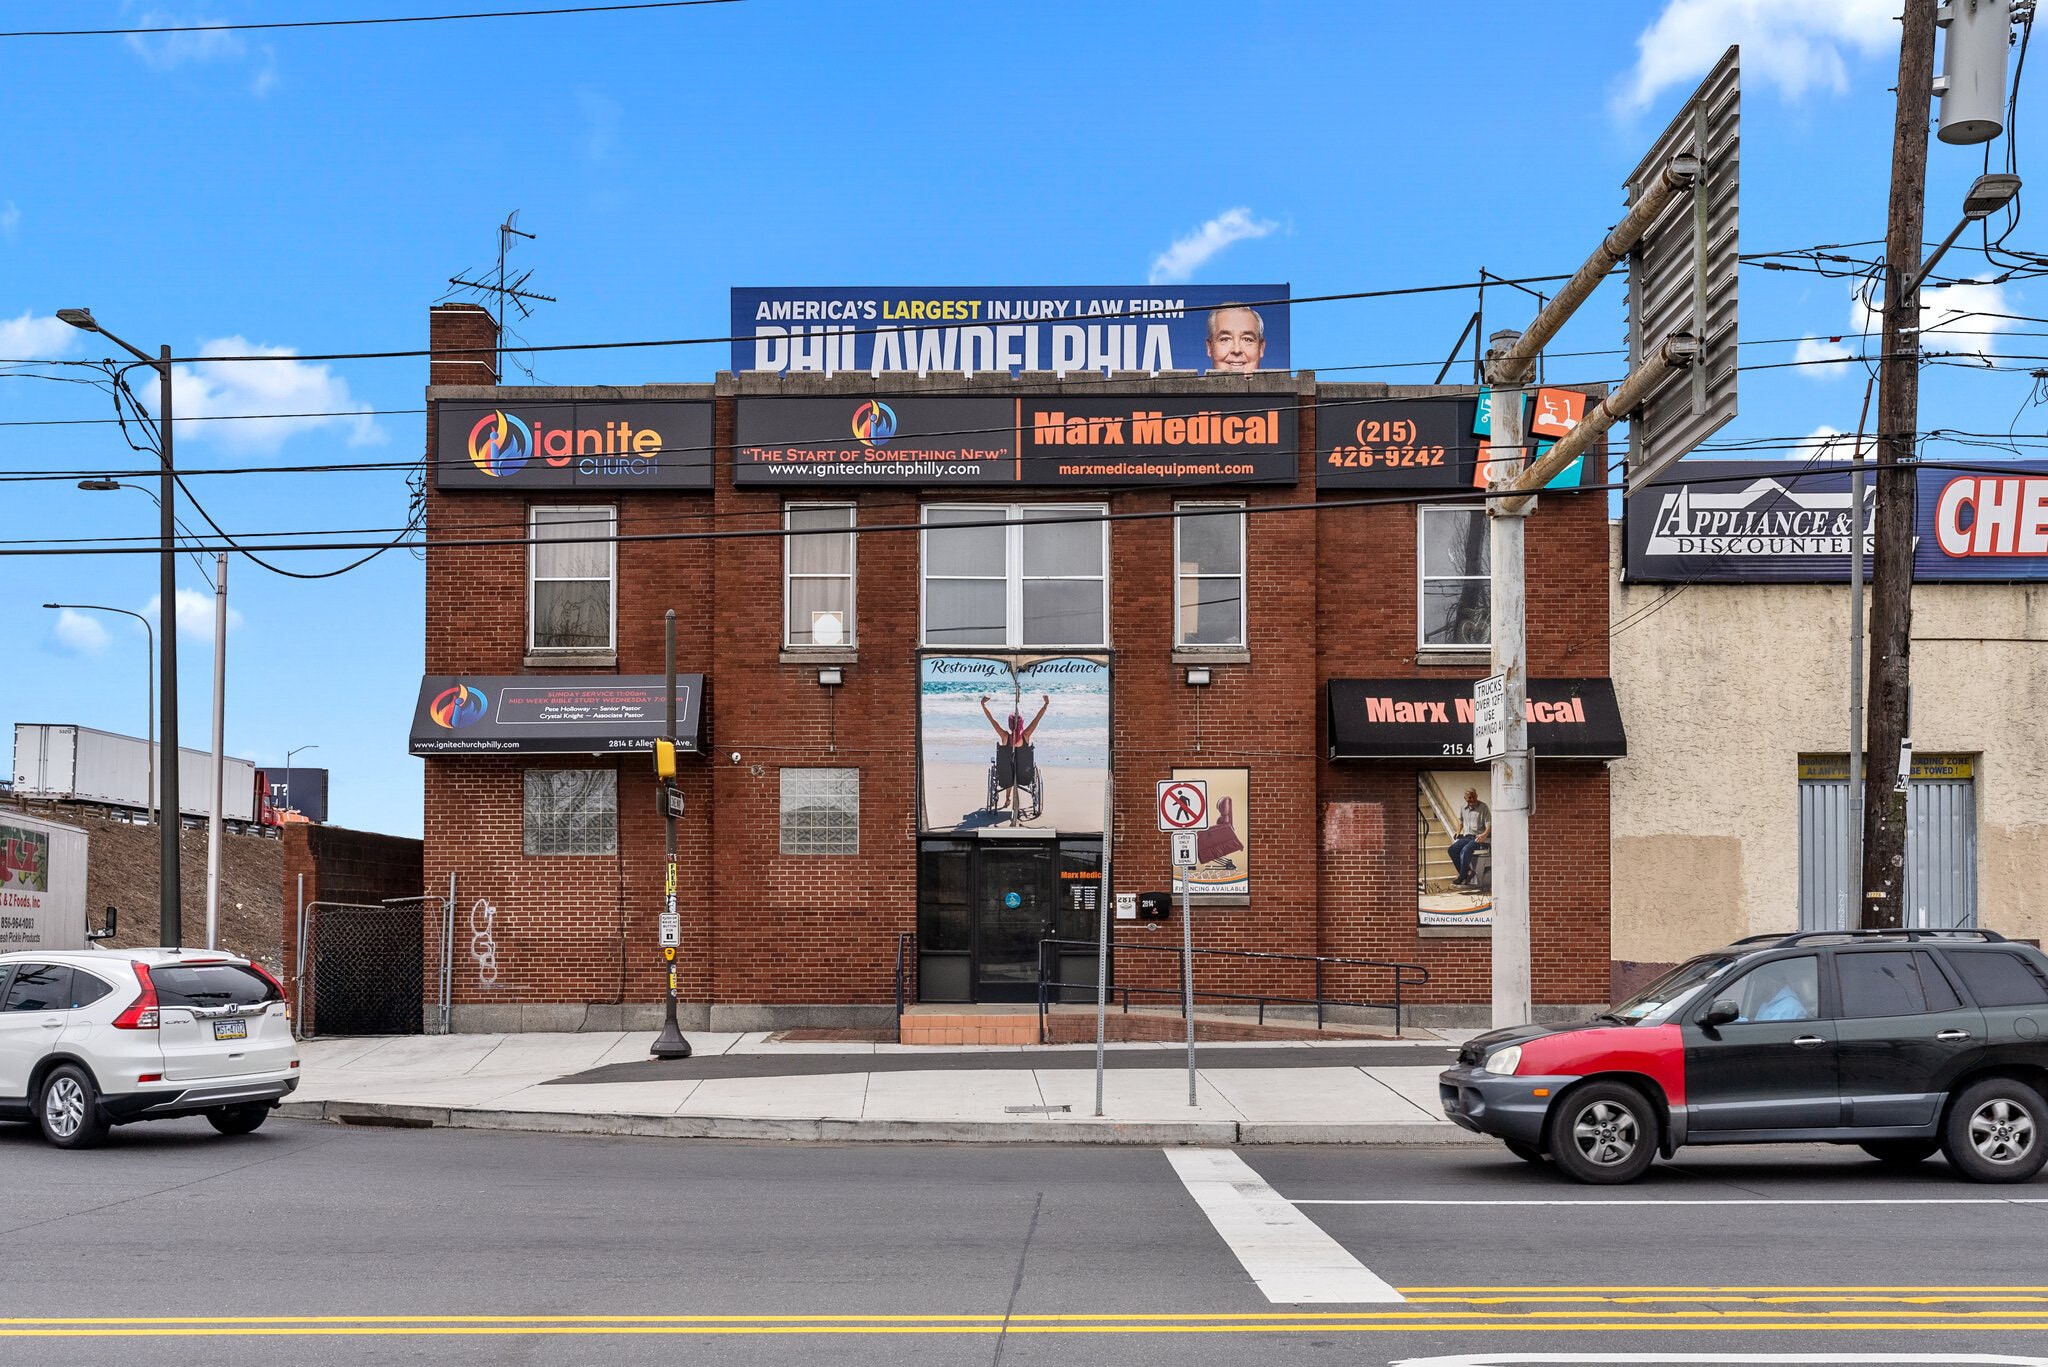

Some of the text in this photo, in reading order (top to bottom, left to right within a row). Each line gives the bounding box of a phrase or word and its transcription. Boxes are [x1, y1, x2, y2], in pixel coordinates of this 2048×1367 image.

[755, 299, 1185, 320] AMERICA'S LARGEST INJURY LAW FIRM
[1033, 411, 1279, 445] Marx Medical
[1356, 419, 1417, 446] (215)
[534, 421, 663, 467] ignite
[864, 449, 956, 461] SOMETHING
[1328, 446, 1445, 468] 426-9242
[579, 458, 658, 475] CHURCH
[768, 462, 980, 477] www.ignitechurchphilly.com
[1059, 463, 1254, 477] marxmedicalequipment.com
[1831, 512, 1853, 536] &
[1678, 537, 1875, 553] DISCOUNTES
[931, 659, 996, 677] Restoring
[1477, 679, 1502, 697] TRUCKS
[560, 705, 590, 713] Holloway
[1365, 697, 1450, 723] Marx
[1475, 697, 1490, 711] OVER
[563, 712, 584, 720] Knight
[1484, 708, 1495, 722] USE
[414, 740, 520, 750] www.ignitechurchphilly.com
[608, 740, 627, 748] 2814
[675, 739, 692, 747] Ave.
[1442, 743, 1464, 755] 215
[1946, 757, 1970, 765] ZONE
[1060, 871, 1102, 879] Marx Medic
